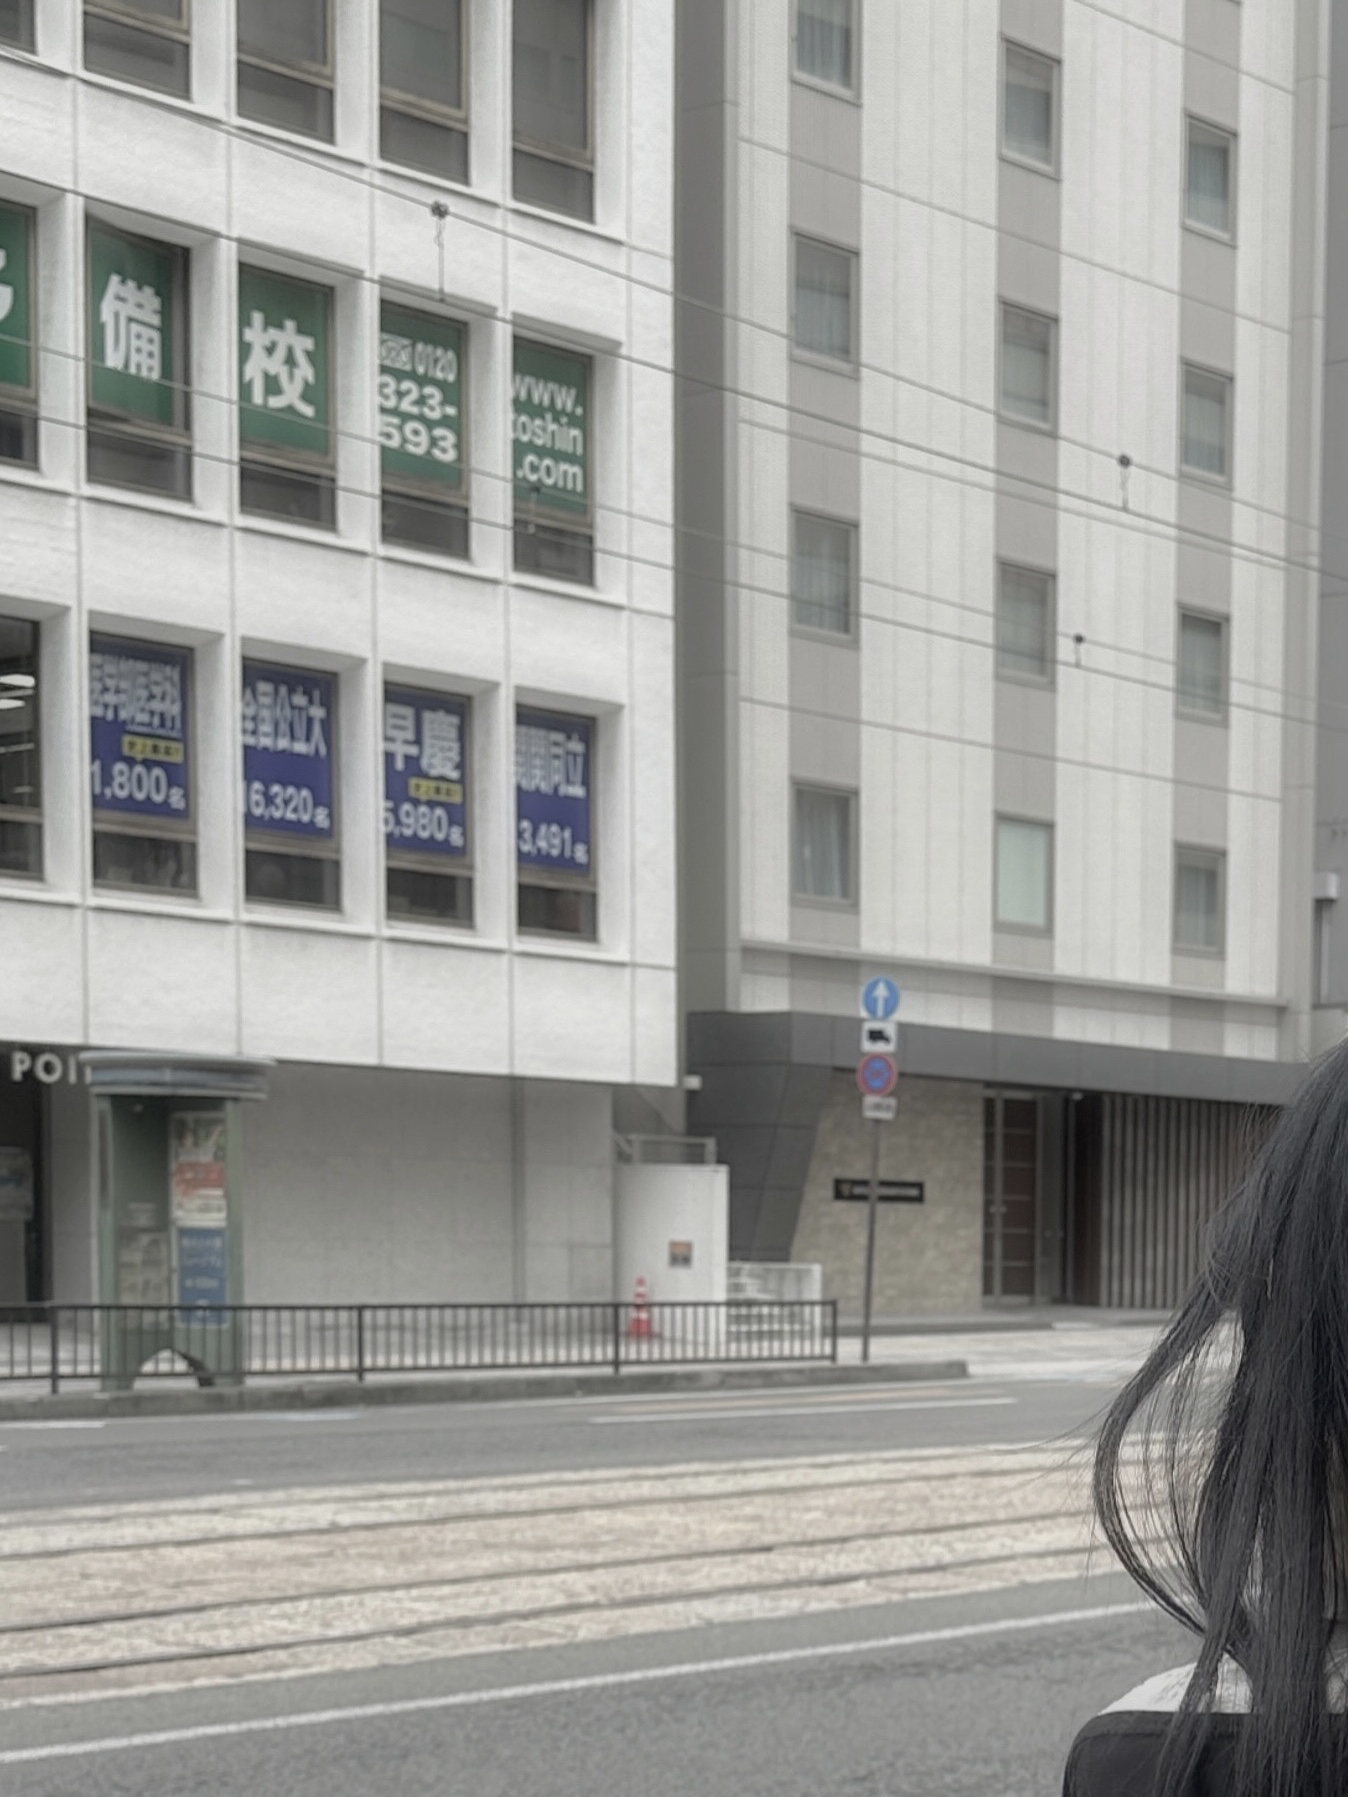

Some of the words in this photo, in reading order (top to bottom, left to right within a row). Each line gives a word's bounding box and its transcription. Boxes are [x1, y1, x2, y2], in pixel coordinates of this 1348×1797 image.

[414, 342, 458, 383] 0120
[378, 373, 458, 420] 323-
[378, 414, 459, 462] 593
[516, 453, 583, 493] .com
[384, 702, 461, 780] 早慶
[244, 779, 331, 830] 6,320名
